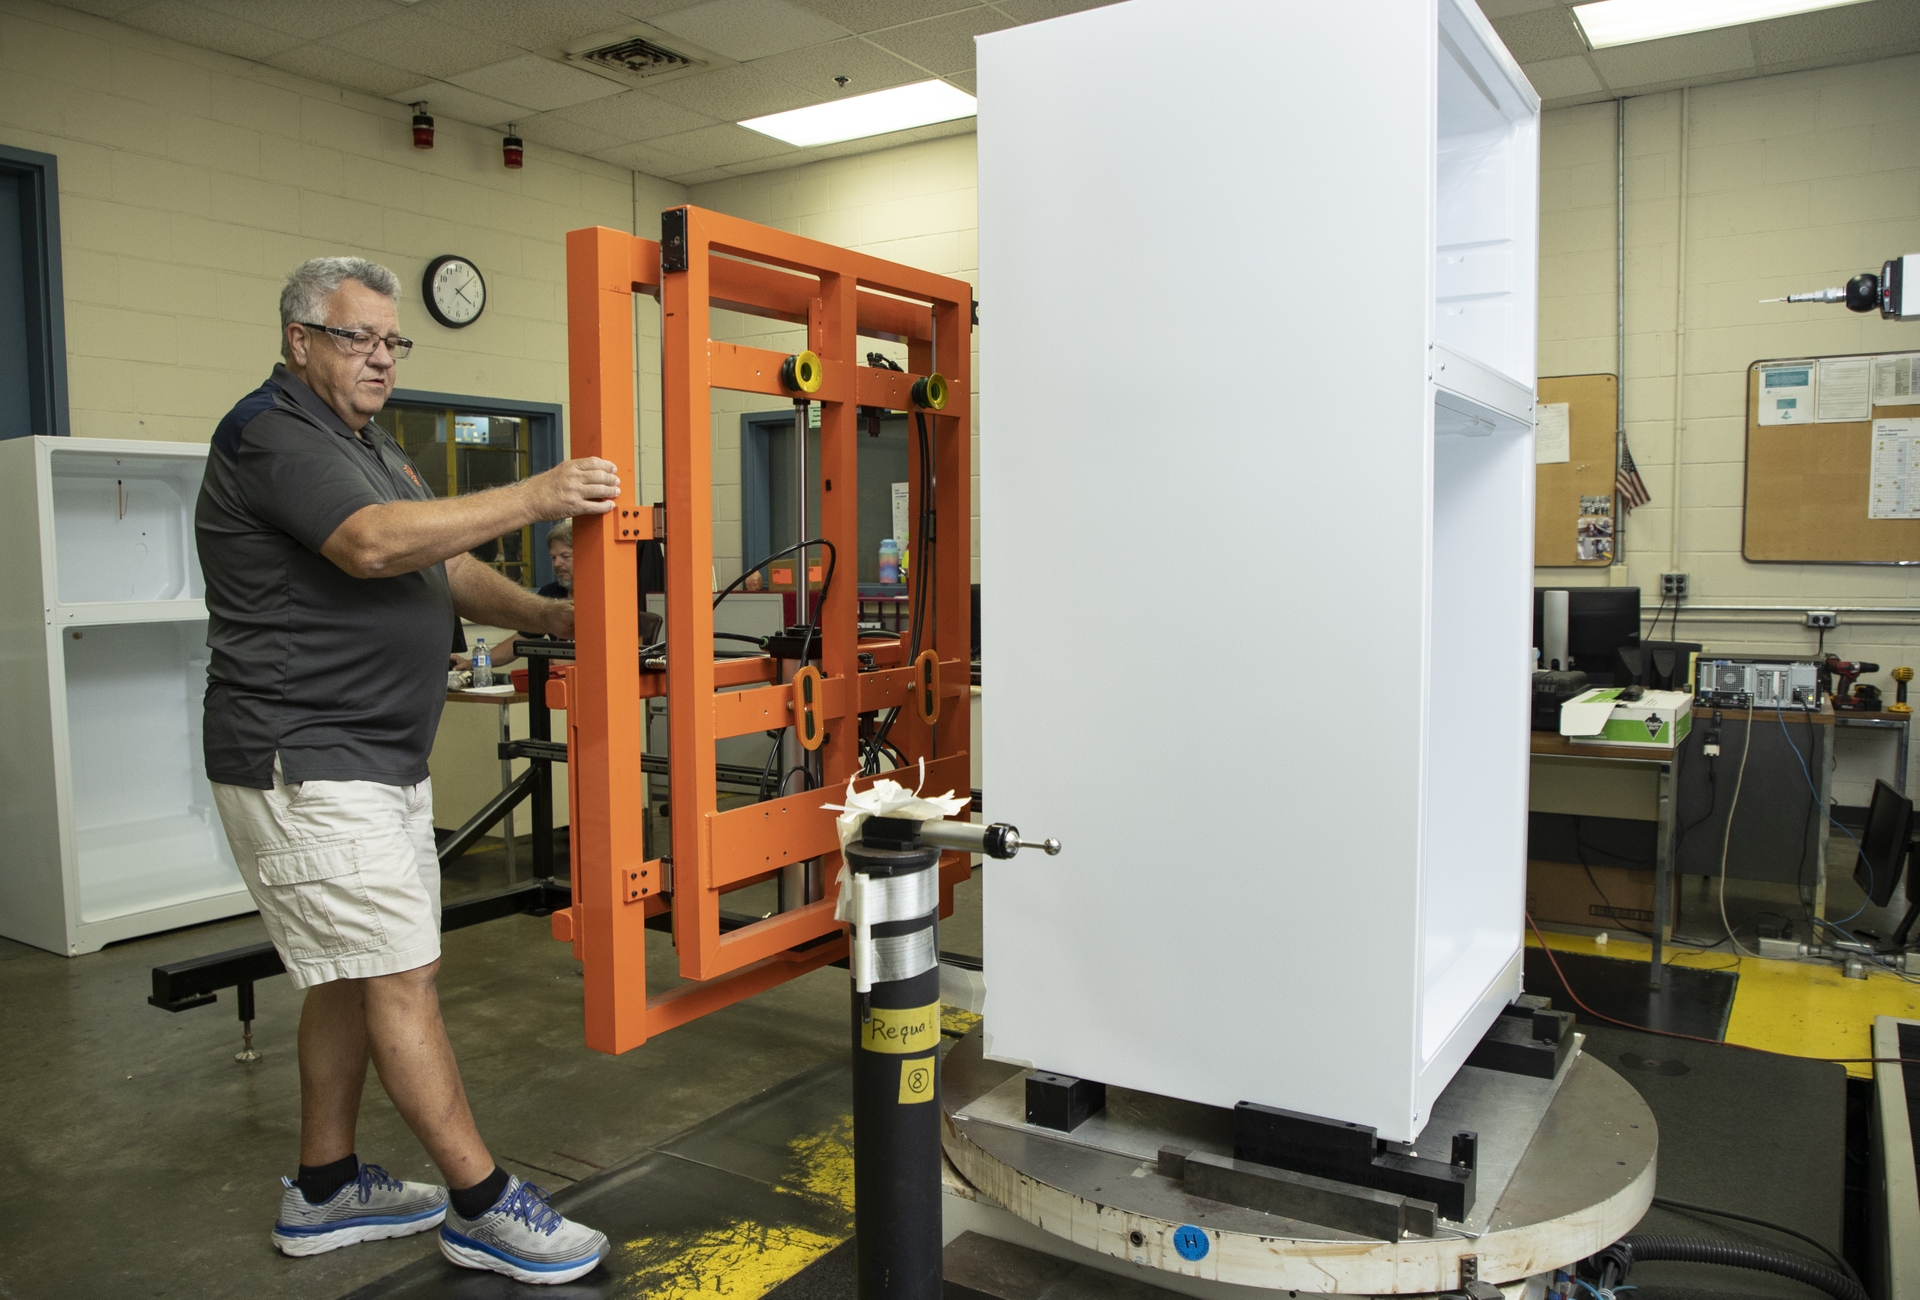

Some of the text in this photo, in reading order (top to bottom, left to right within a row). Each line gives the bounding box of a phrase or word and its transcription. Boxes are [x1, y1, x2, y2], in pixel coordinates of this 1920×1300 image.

[446, 267, 453, 275] 11
[455, 264, 462, 273] 12
[440, 275, 448, 283] 10
[1183, 1234, 1198, 1249] H
